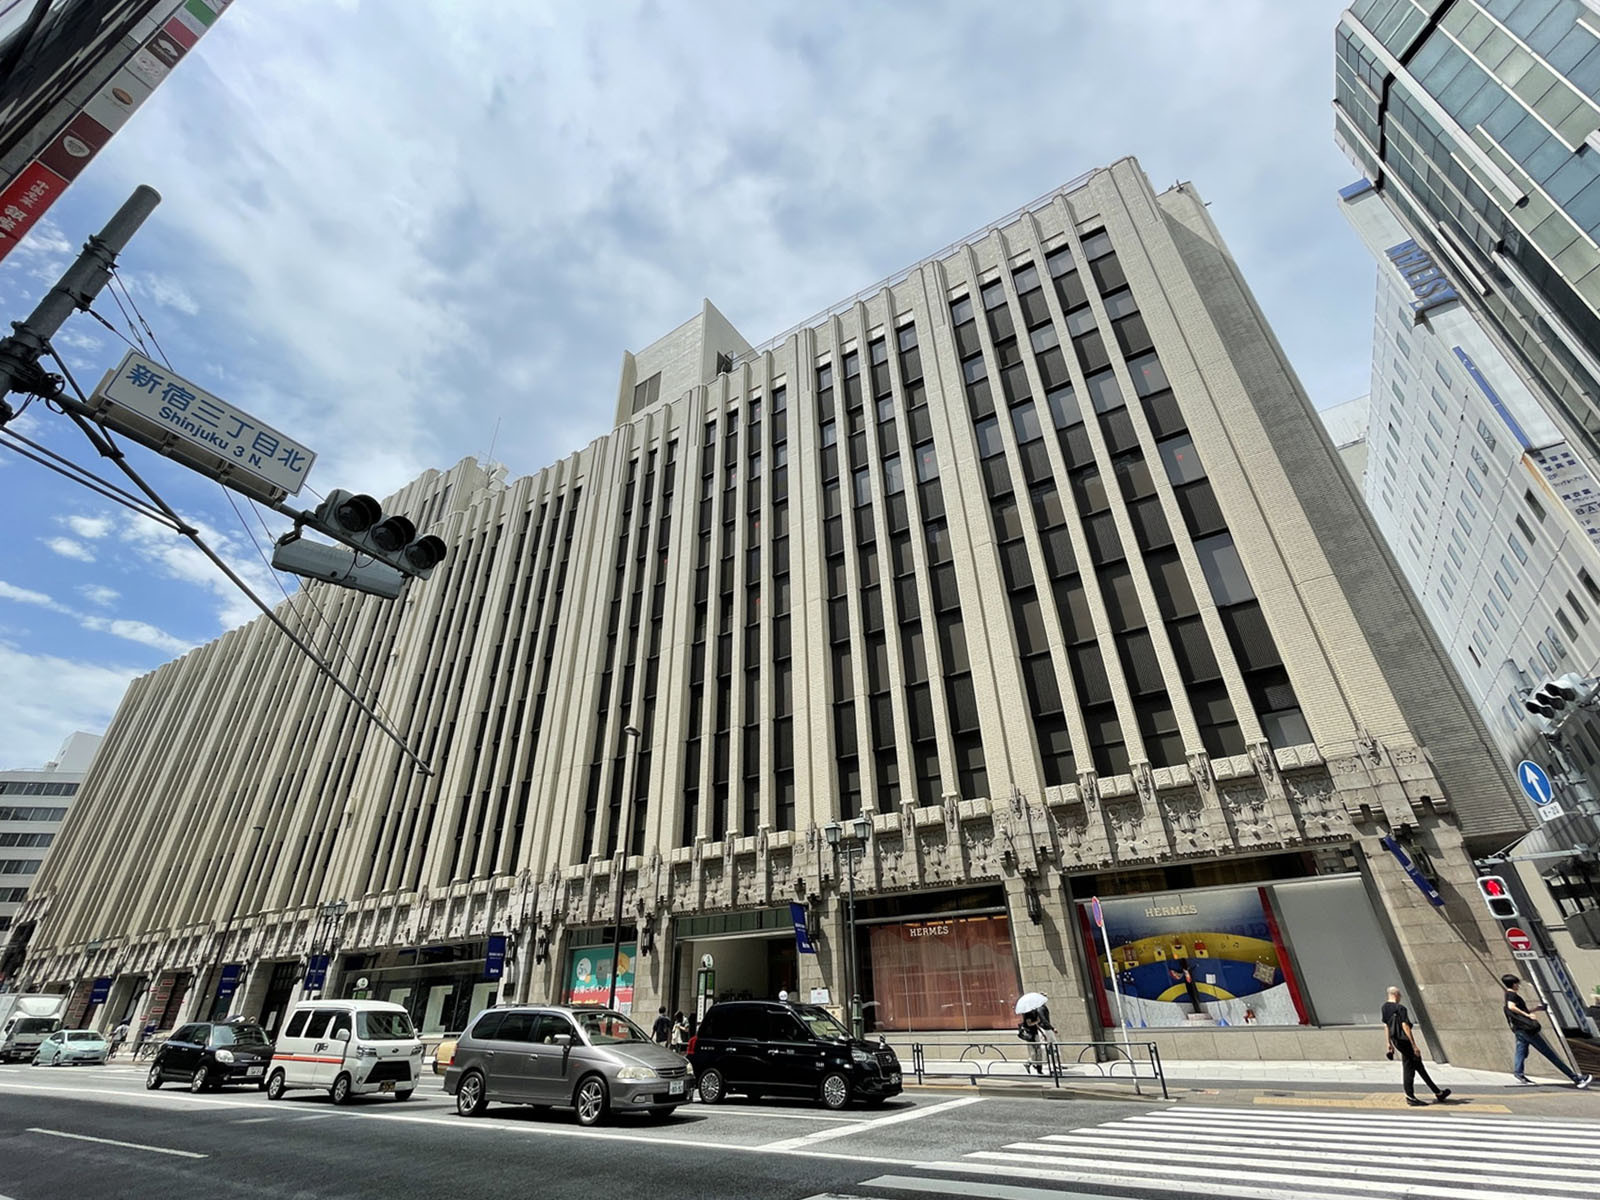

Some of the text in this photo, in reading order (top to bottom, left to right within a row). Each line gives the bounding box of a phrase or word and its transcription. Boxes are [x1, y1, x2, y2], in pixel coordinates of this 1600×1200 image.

[126, 363, 305, 472] 新宿三丁目北
[159, 407, 263, 470] Shinjuku 3 N.
